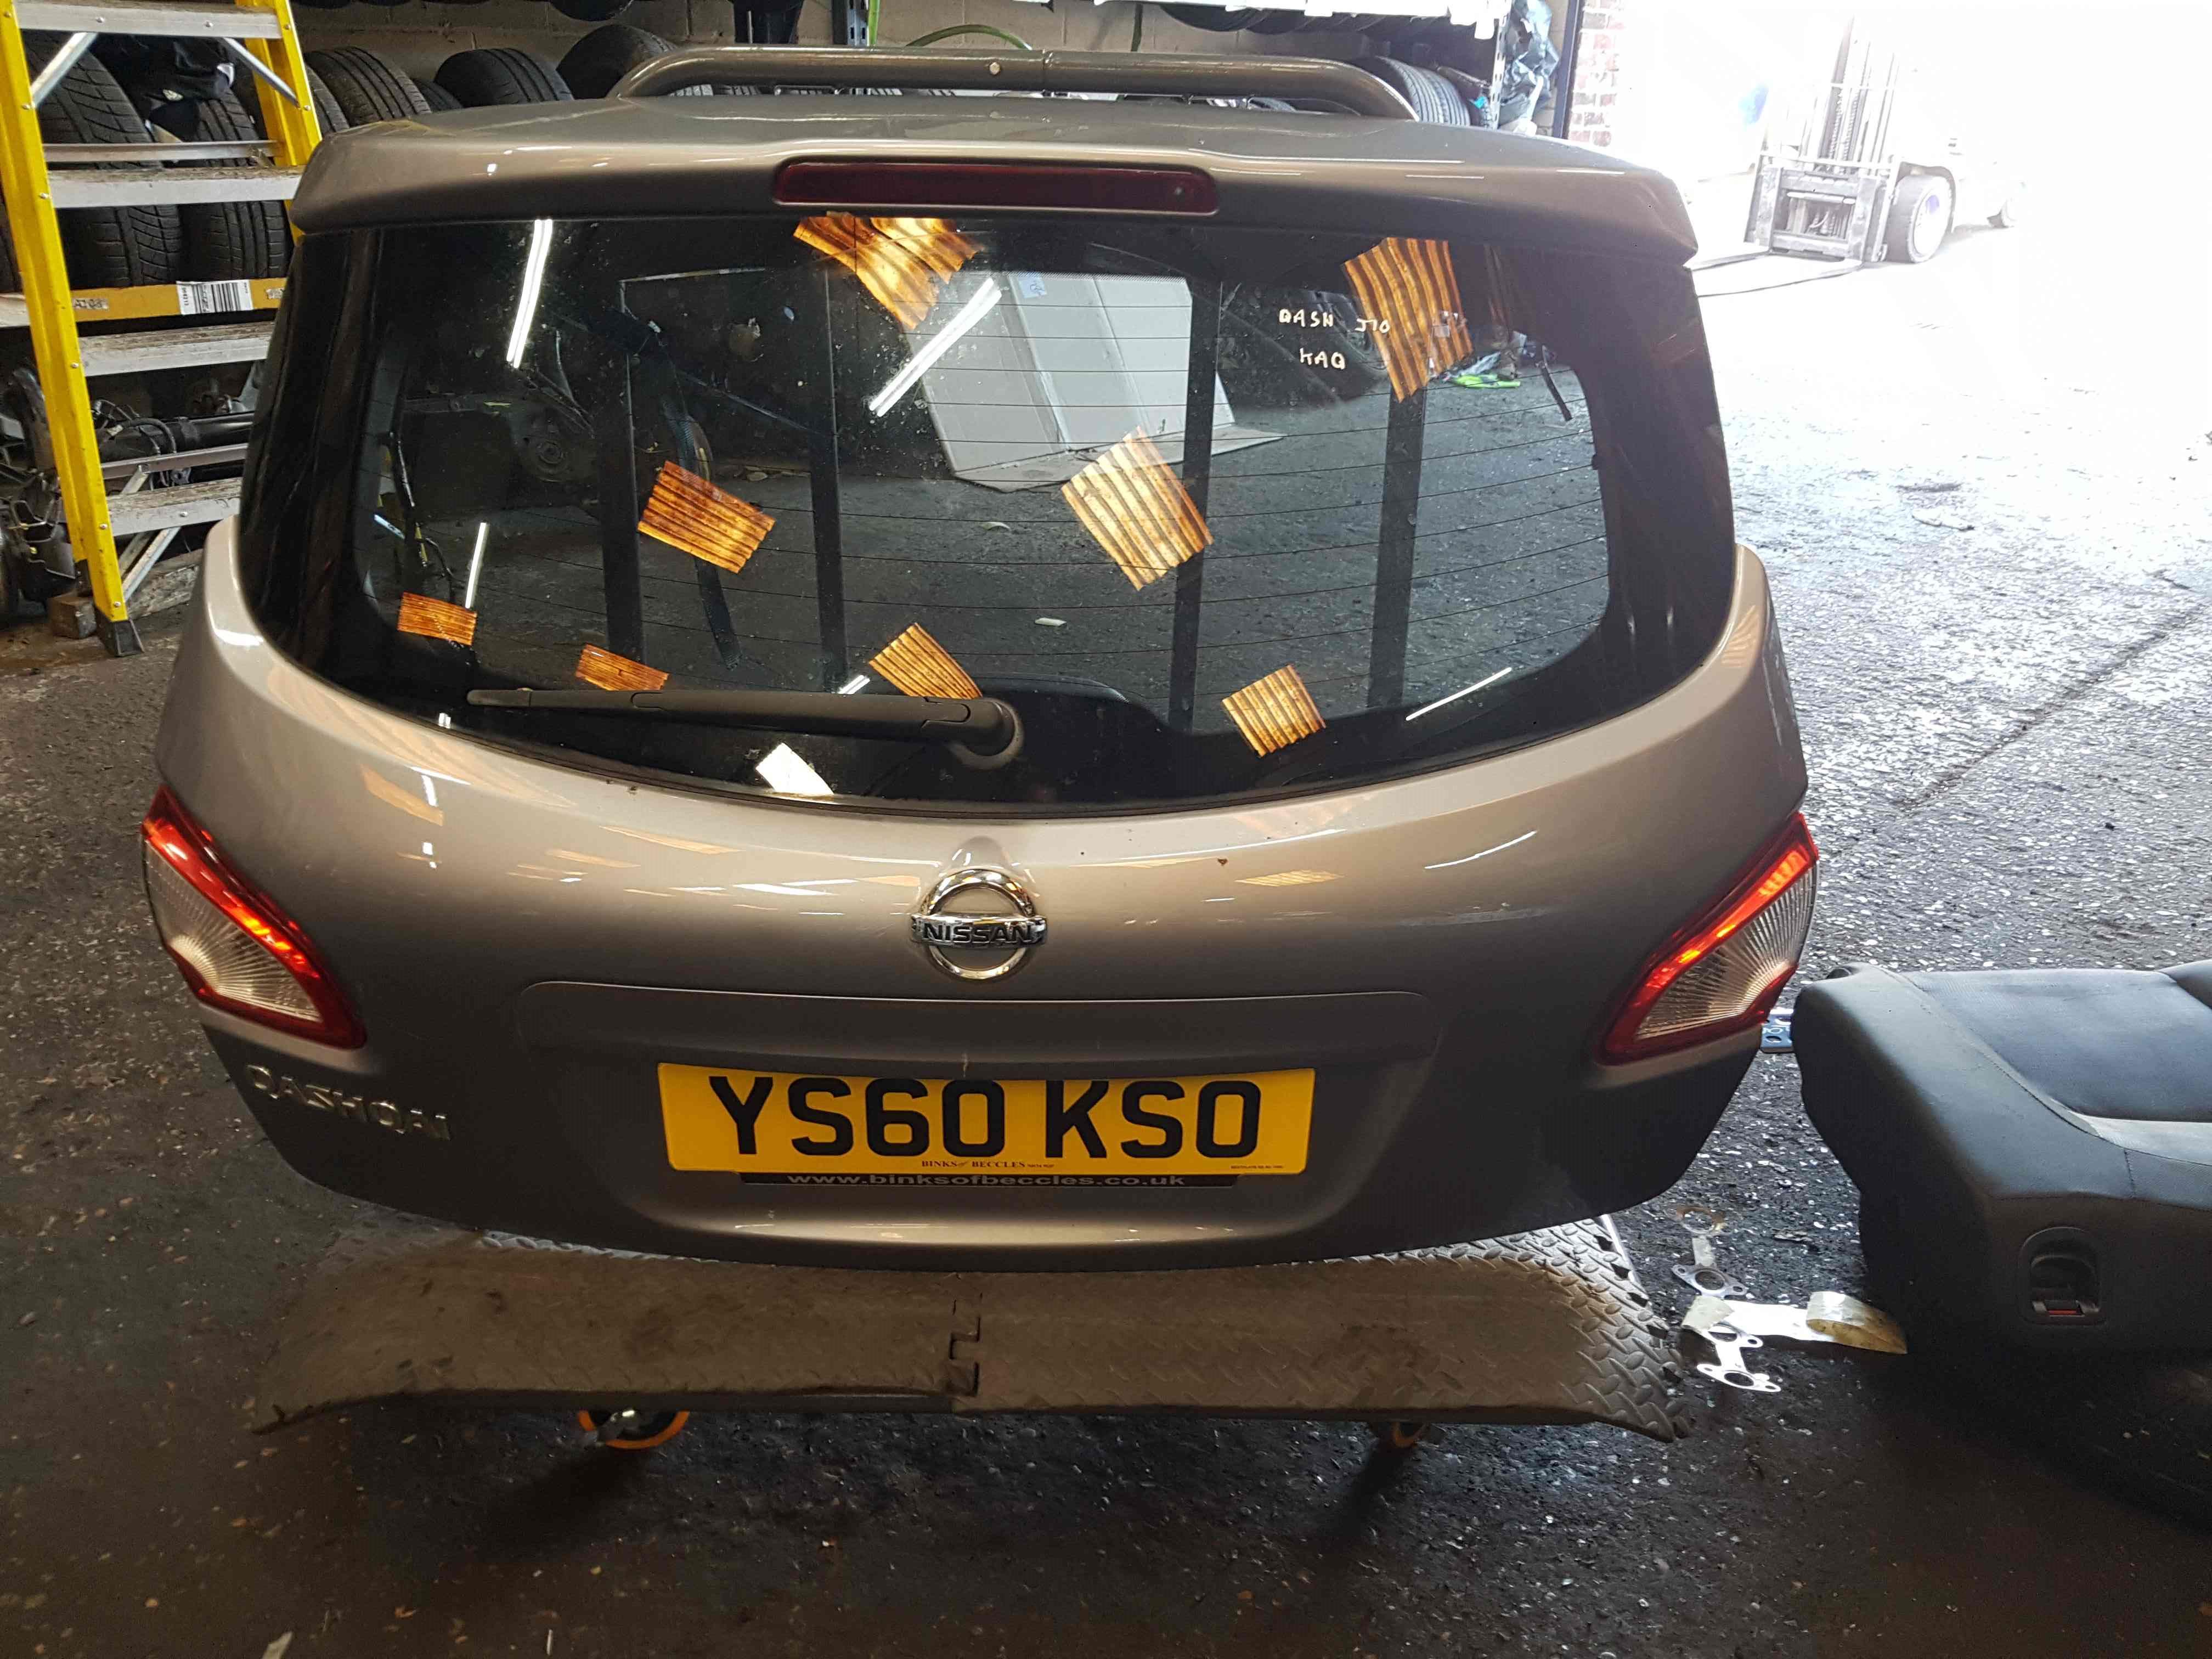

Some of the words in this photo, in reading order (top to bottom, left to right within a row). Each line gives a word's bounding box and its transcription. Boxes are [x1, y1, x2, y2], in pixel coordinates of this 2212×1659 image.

[1355, 318, 1390, 334] J10
[923, 922, 1031, 943] NISSAN
[246, 1064, 451, 1142] QASHQAI
[708, 1076, 1005, 1156] YS60
[1045, 1080, 1261, 1158] KSO
[787, 1175, 1186, 1187] www.binksofbeccles.co.uk
